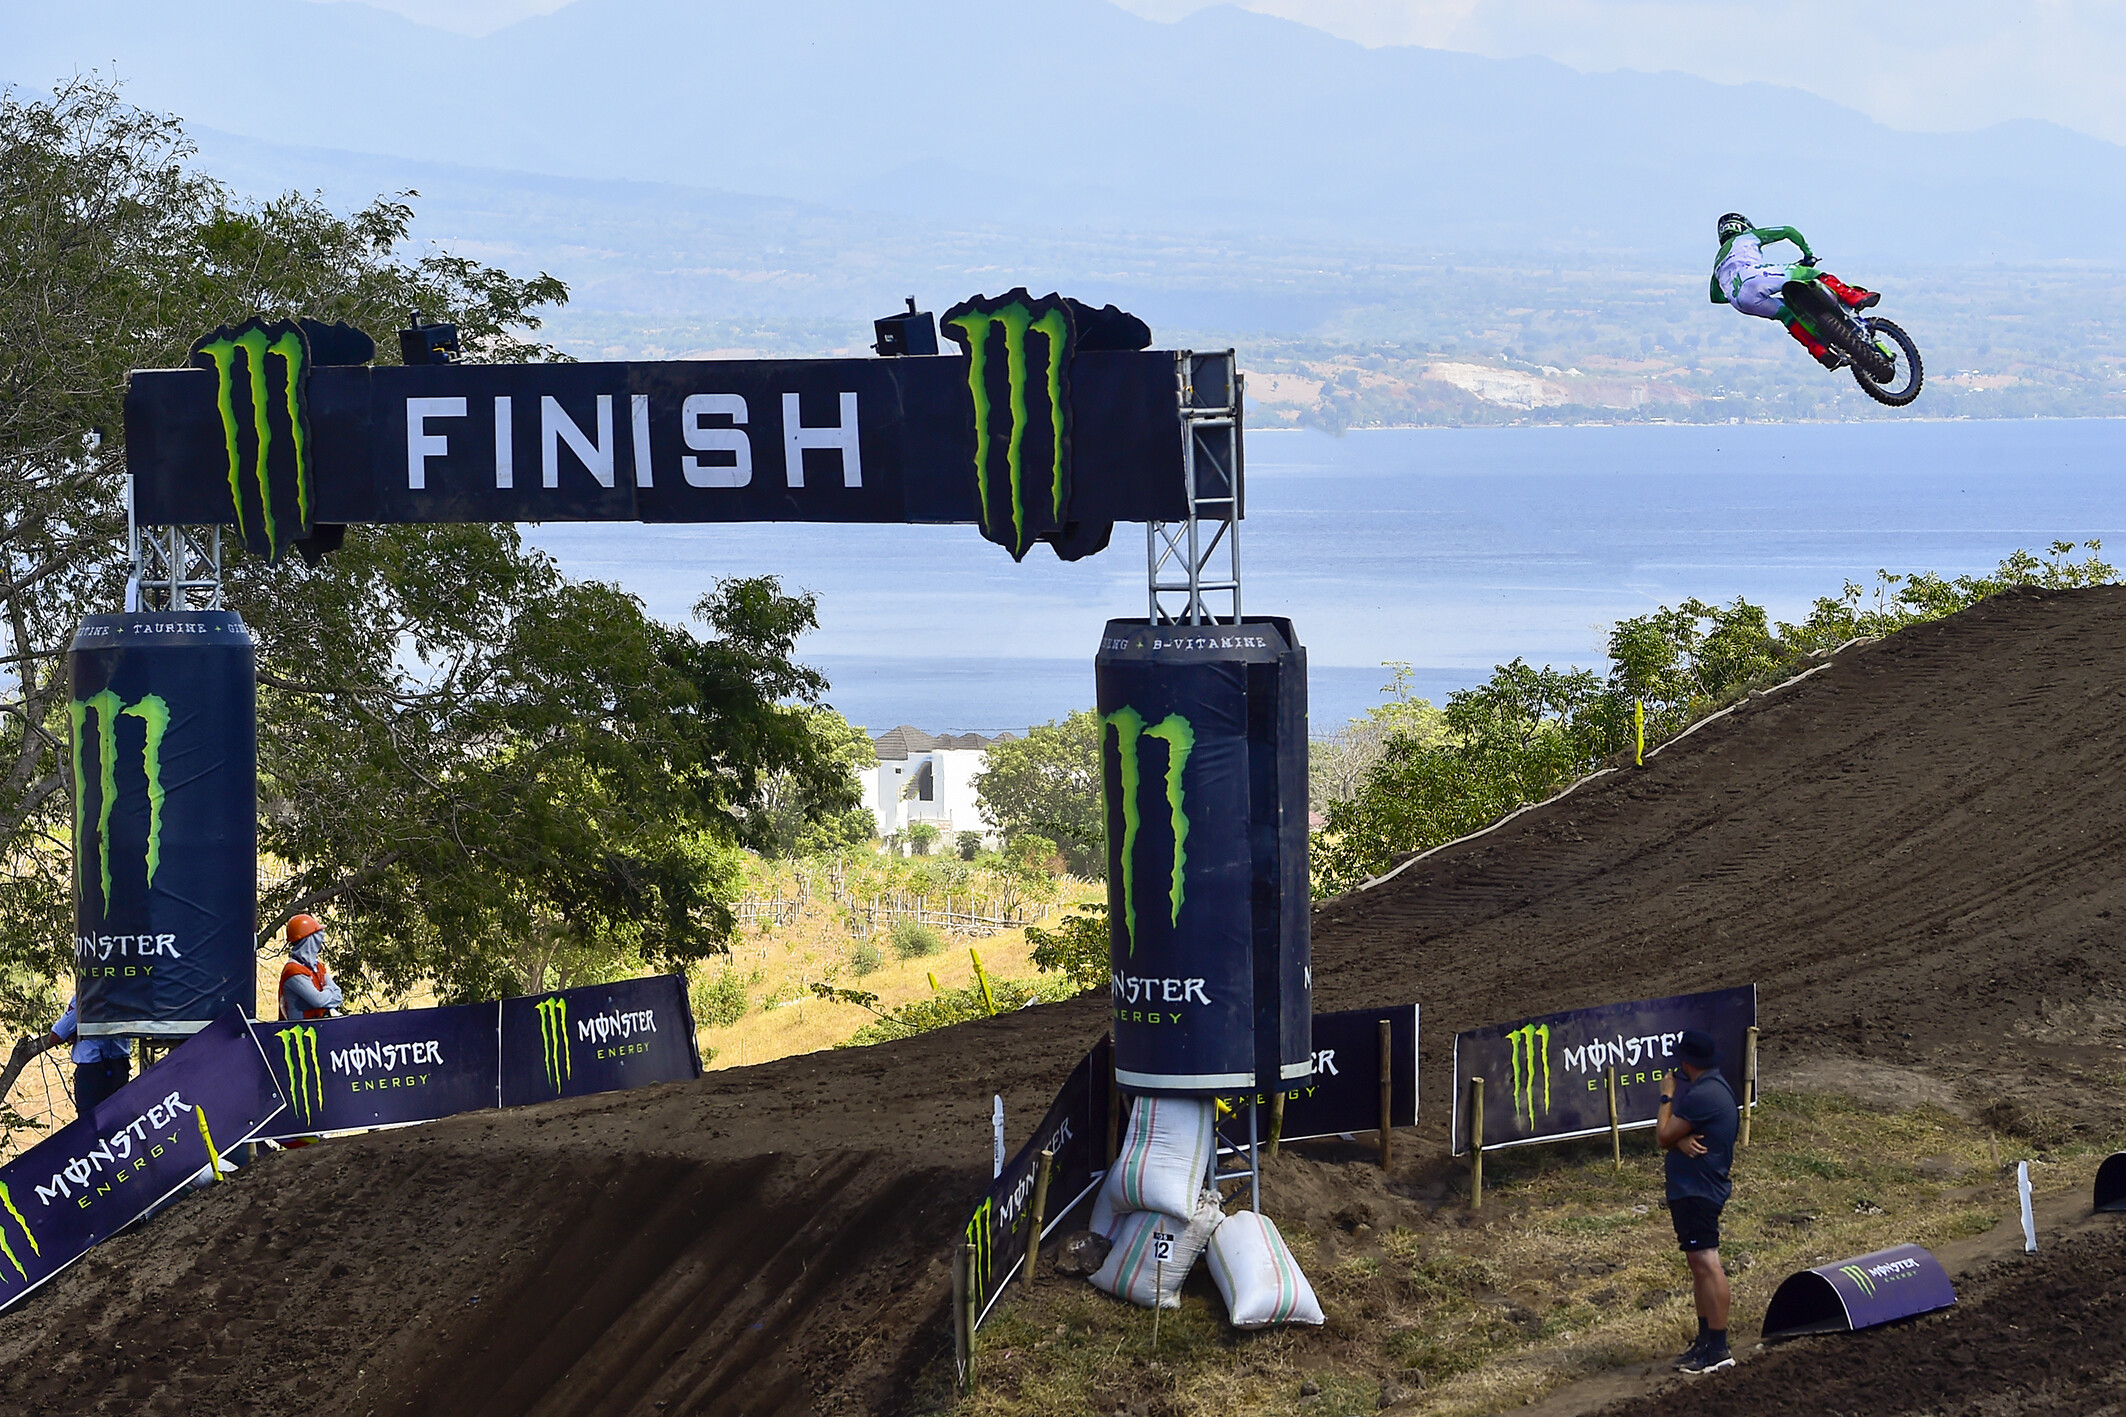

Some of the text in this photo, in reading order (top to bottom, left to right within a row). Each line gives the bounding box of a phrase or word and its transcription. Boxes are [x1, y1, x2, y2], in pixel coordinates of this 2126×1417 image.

[406, 391, 863, 489] FINISH
[133, 623, 207, 635] TAURINE
[1153, 635, 1267, 650] B-VITAMINE
[577, 1009, 657, 1045] MONSTER
[329, 1040, 444, 1076] MONSTER
[596, 1041, 650, 1060] ENERGY
[1563, 1030, 1685, 1075] MONSTE
[351, 1074, 428, 1093] ENERGY
[34, 1090, 193, 1207] MONSTER
[77, 1131, 179, 1210] ENERGY
[1154, 1240, 1170, 1259] 12
[1867, 1257, 1921, 1278] MONSTER
